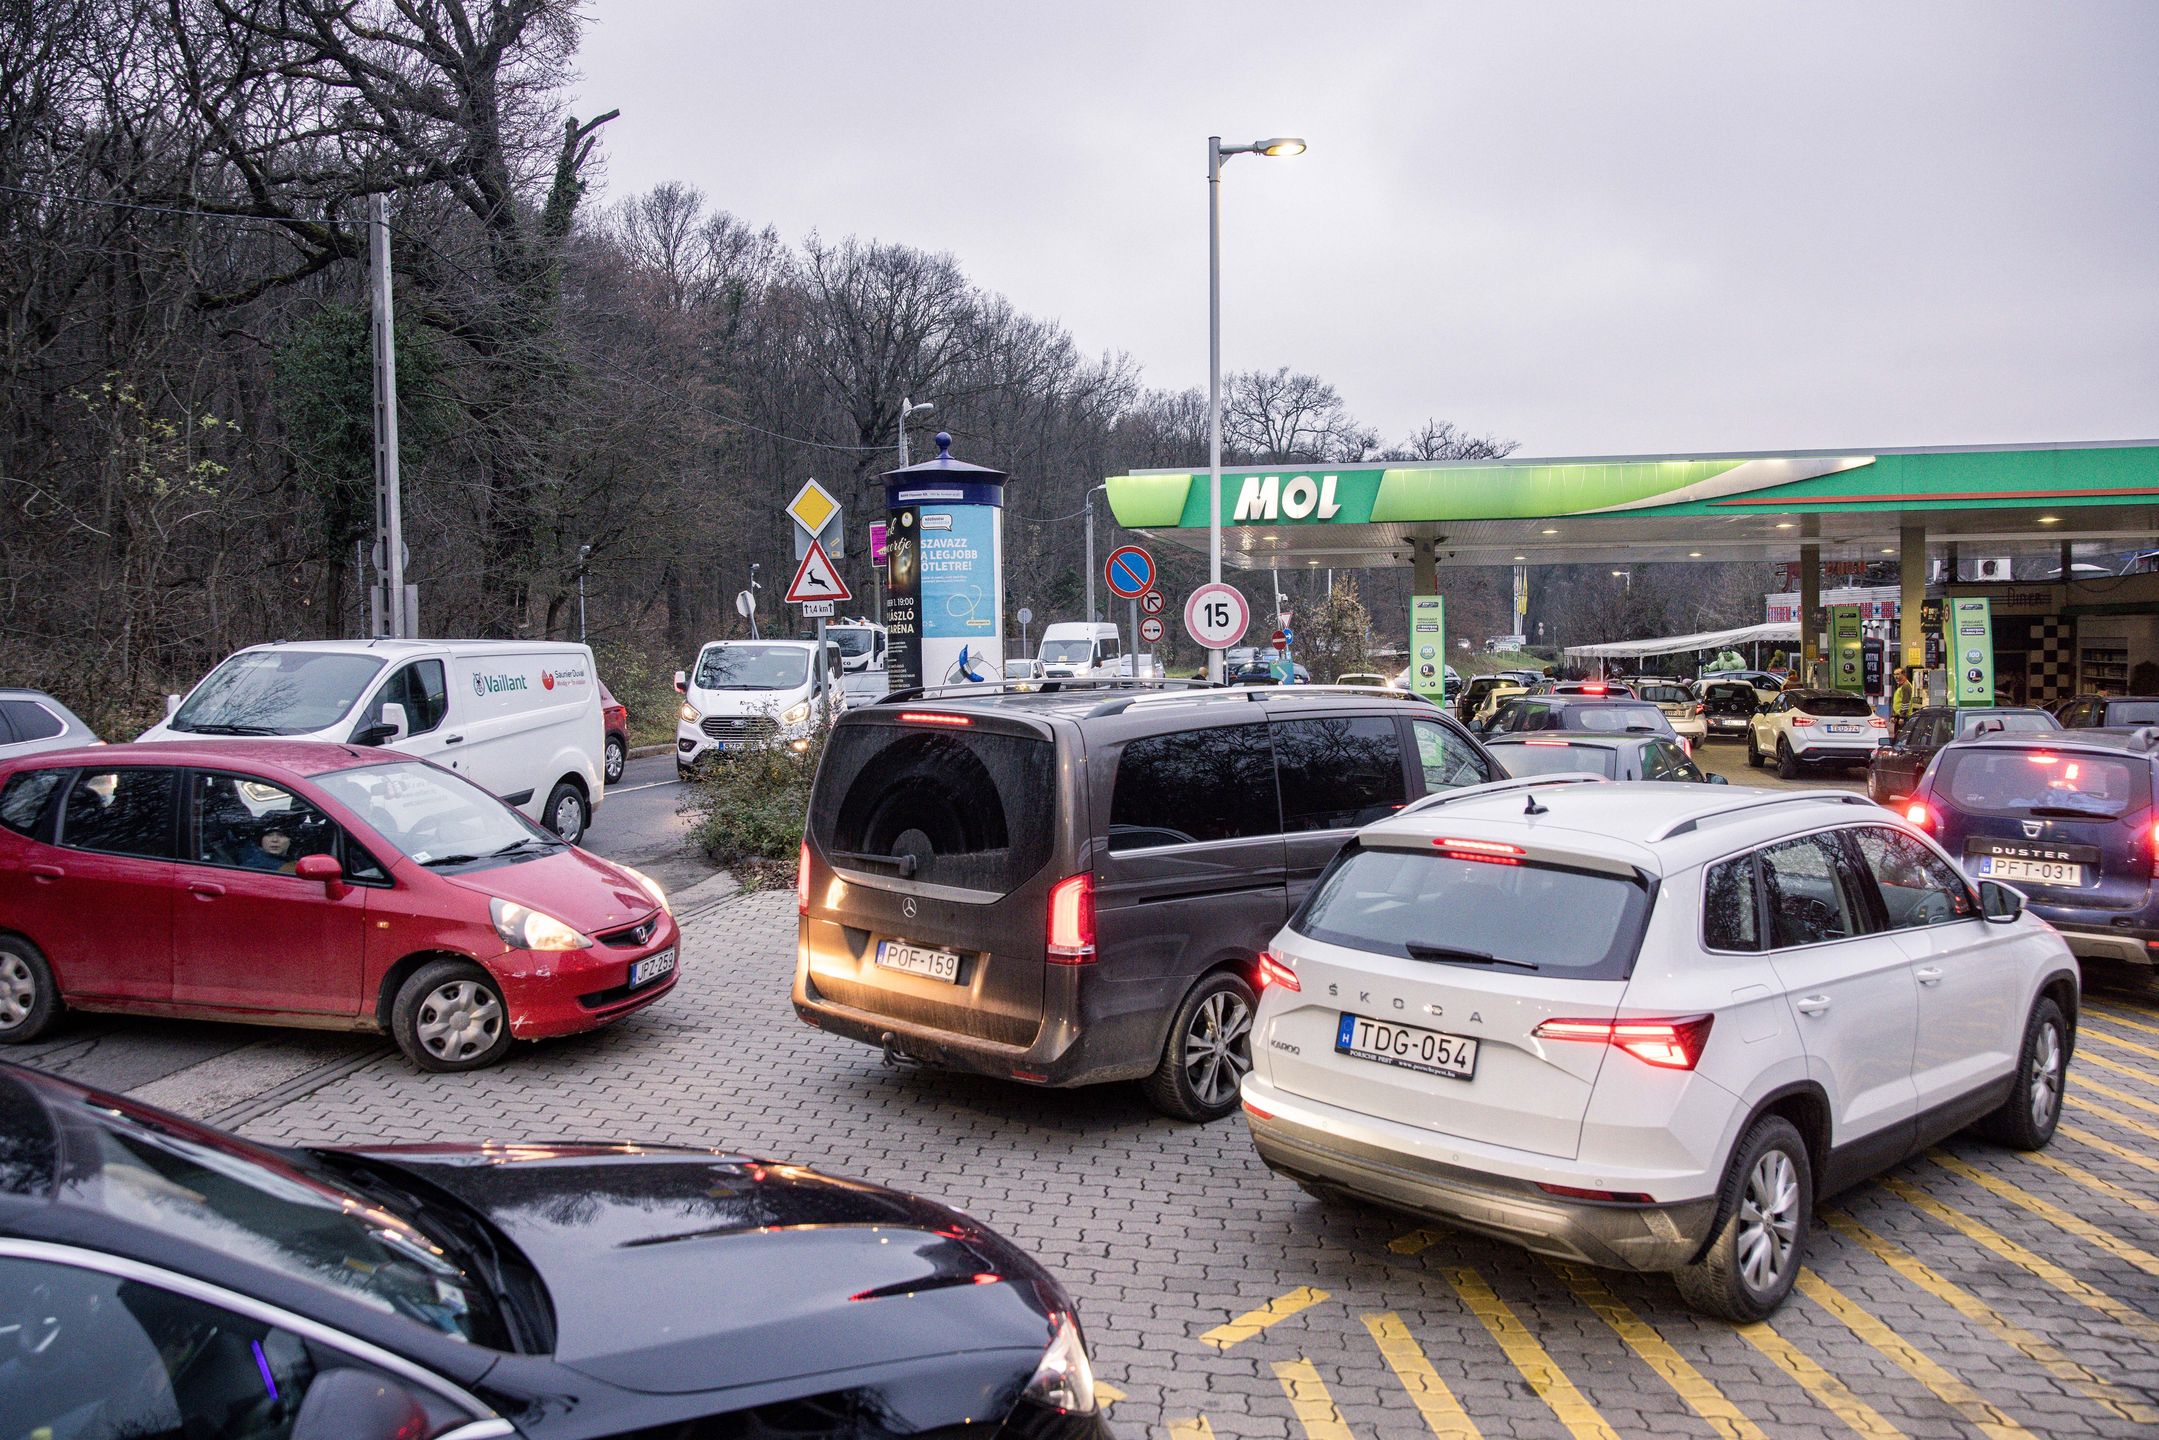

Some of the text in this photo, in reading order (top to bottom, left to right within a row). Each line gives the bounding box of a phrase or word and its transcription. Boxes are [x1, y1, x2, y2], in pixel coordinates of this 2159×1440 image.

[1233, 475, 1342, 520] MOL
[921, 538, 967, 549] SZAVAZZ
[921, 550, 978, 560] A LEGJOBB
[921, 560, 972, 571] ÖTLETRE!
[819, 604, 828, 613] km
[897, 597, 914, 606] 19:00
[1204, 603, 1229, 627] 15
[484, 674, 528, 693] Vaillant
[1992, 846, 2070, 859] DUSTER
[1995, 860, 2074, 881] PFT-031
[638, 952, 673, 981] JPZ-259
[887, 946, 955, 976] POF-159
[1270, 1039, 1300, 1056] KAROQ
[1342, 1022, 1467, 1068] H TDG-054
[1350, 1050, 1377, 1061] PORSCHE
